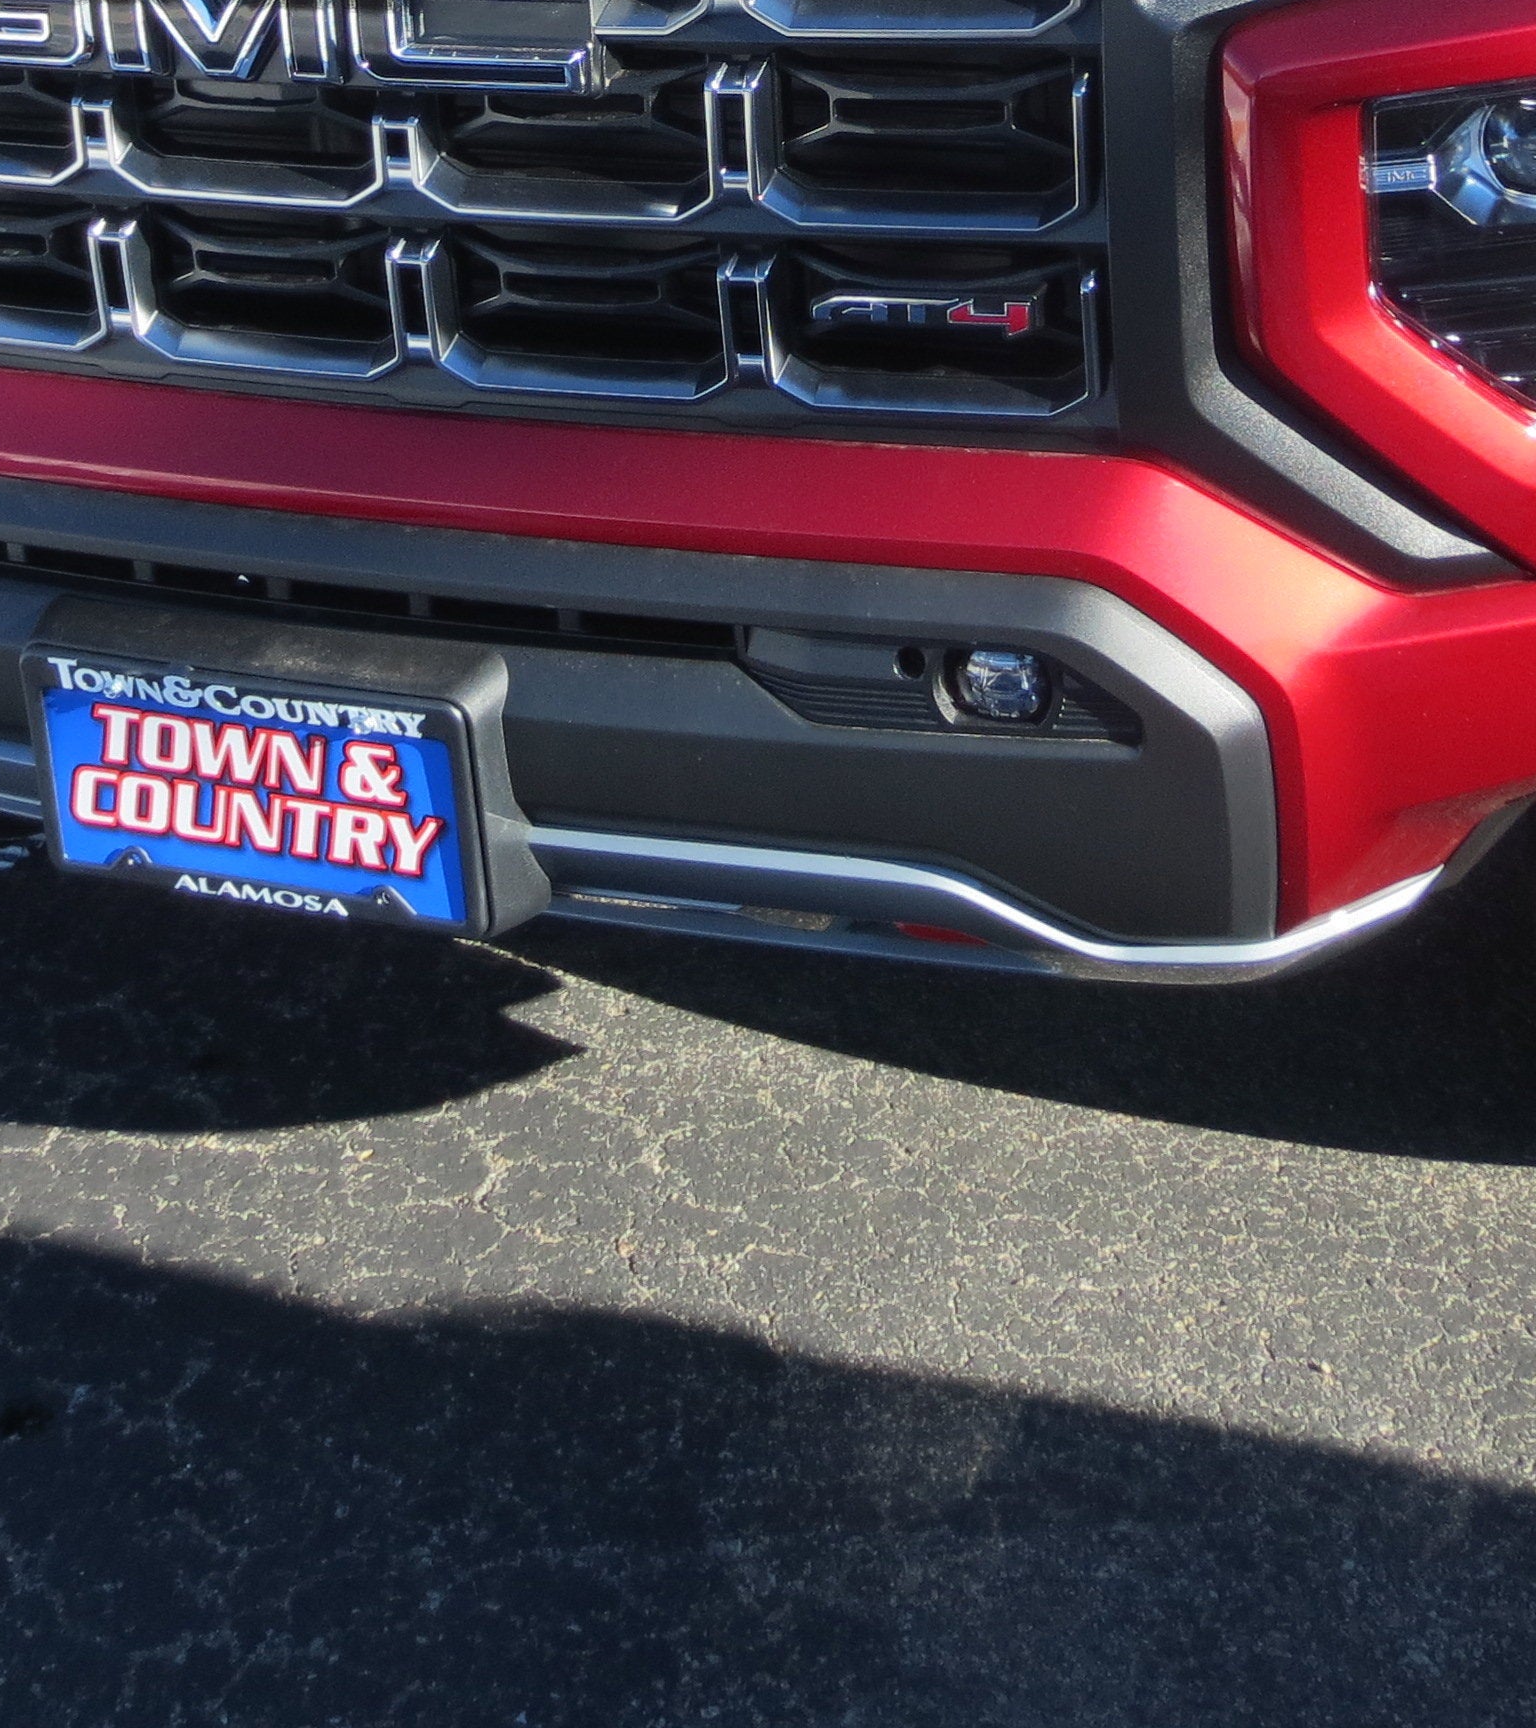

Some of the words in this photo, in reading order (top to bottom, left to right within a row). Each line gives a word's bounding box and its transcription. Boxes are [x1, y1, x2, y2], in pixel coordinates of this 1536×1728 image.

[812, 293, 1031, 337] AT4
[92, 702, 326, 795] TOWN
[339, 741, 408, 807] &
[72, 765, 445, 876] COUNTRY
[174, 874, 350, 918] ALAMOSA
